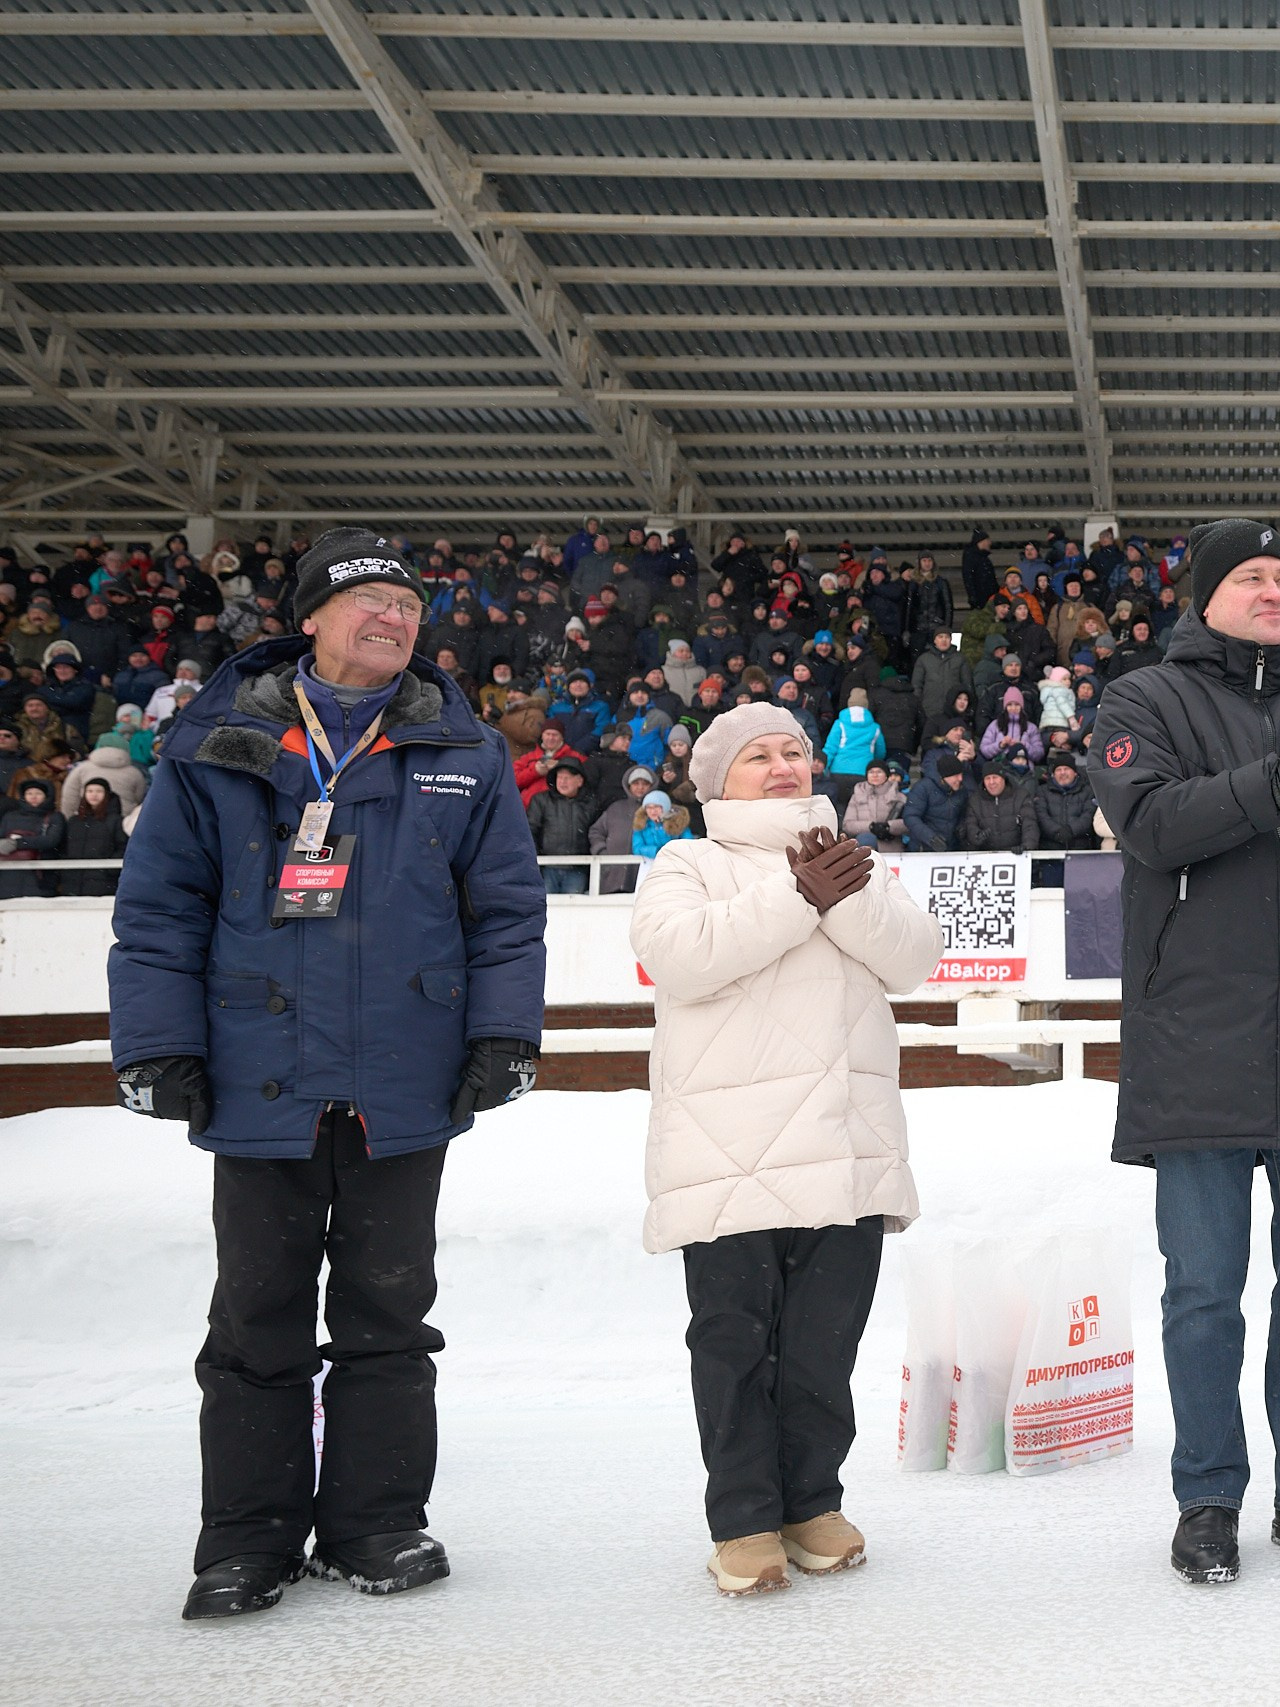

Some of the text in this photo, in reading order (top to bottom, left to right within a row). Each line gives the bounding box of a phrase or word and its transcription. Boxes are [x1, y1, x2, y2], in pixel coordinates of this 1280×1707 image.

[432, 786, 464, 795] Гольцов
[295, 868, 335, 877] СПОРТИВНЫЙ
[297, 878, 329, 886] КОМИССАР
